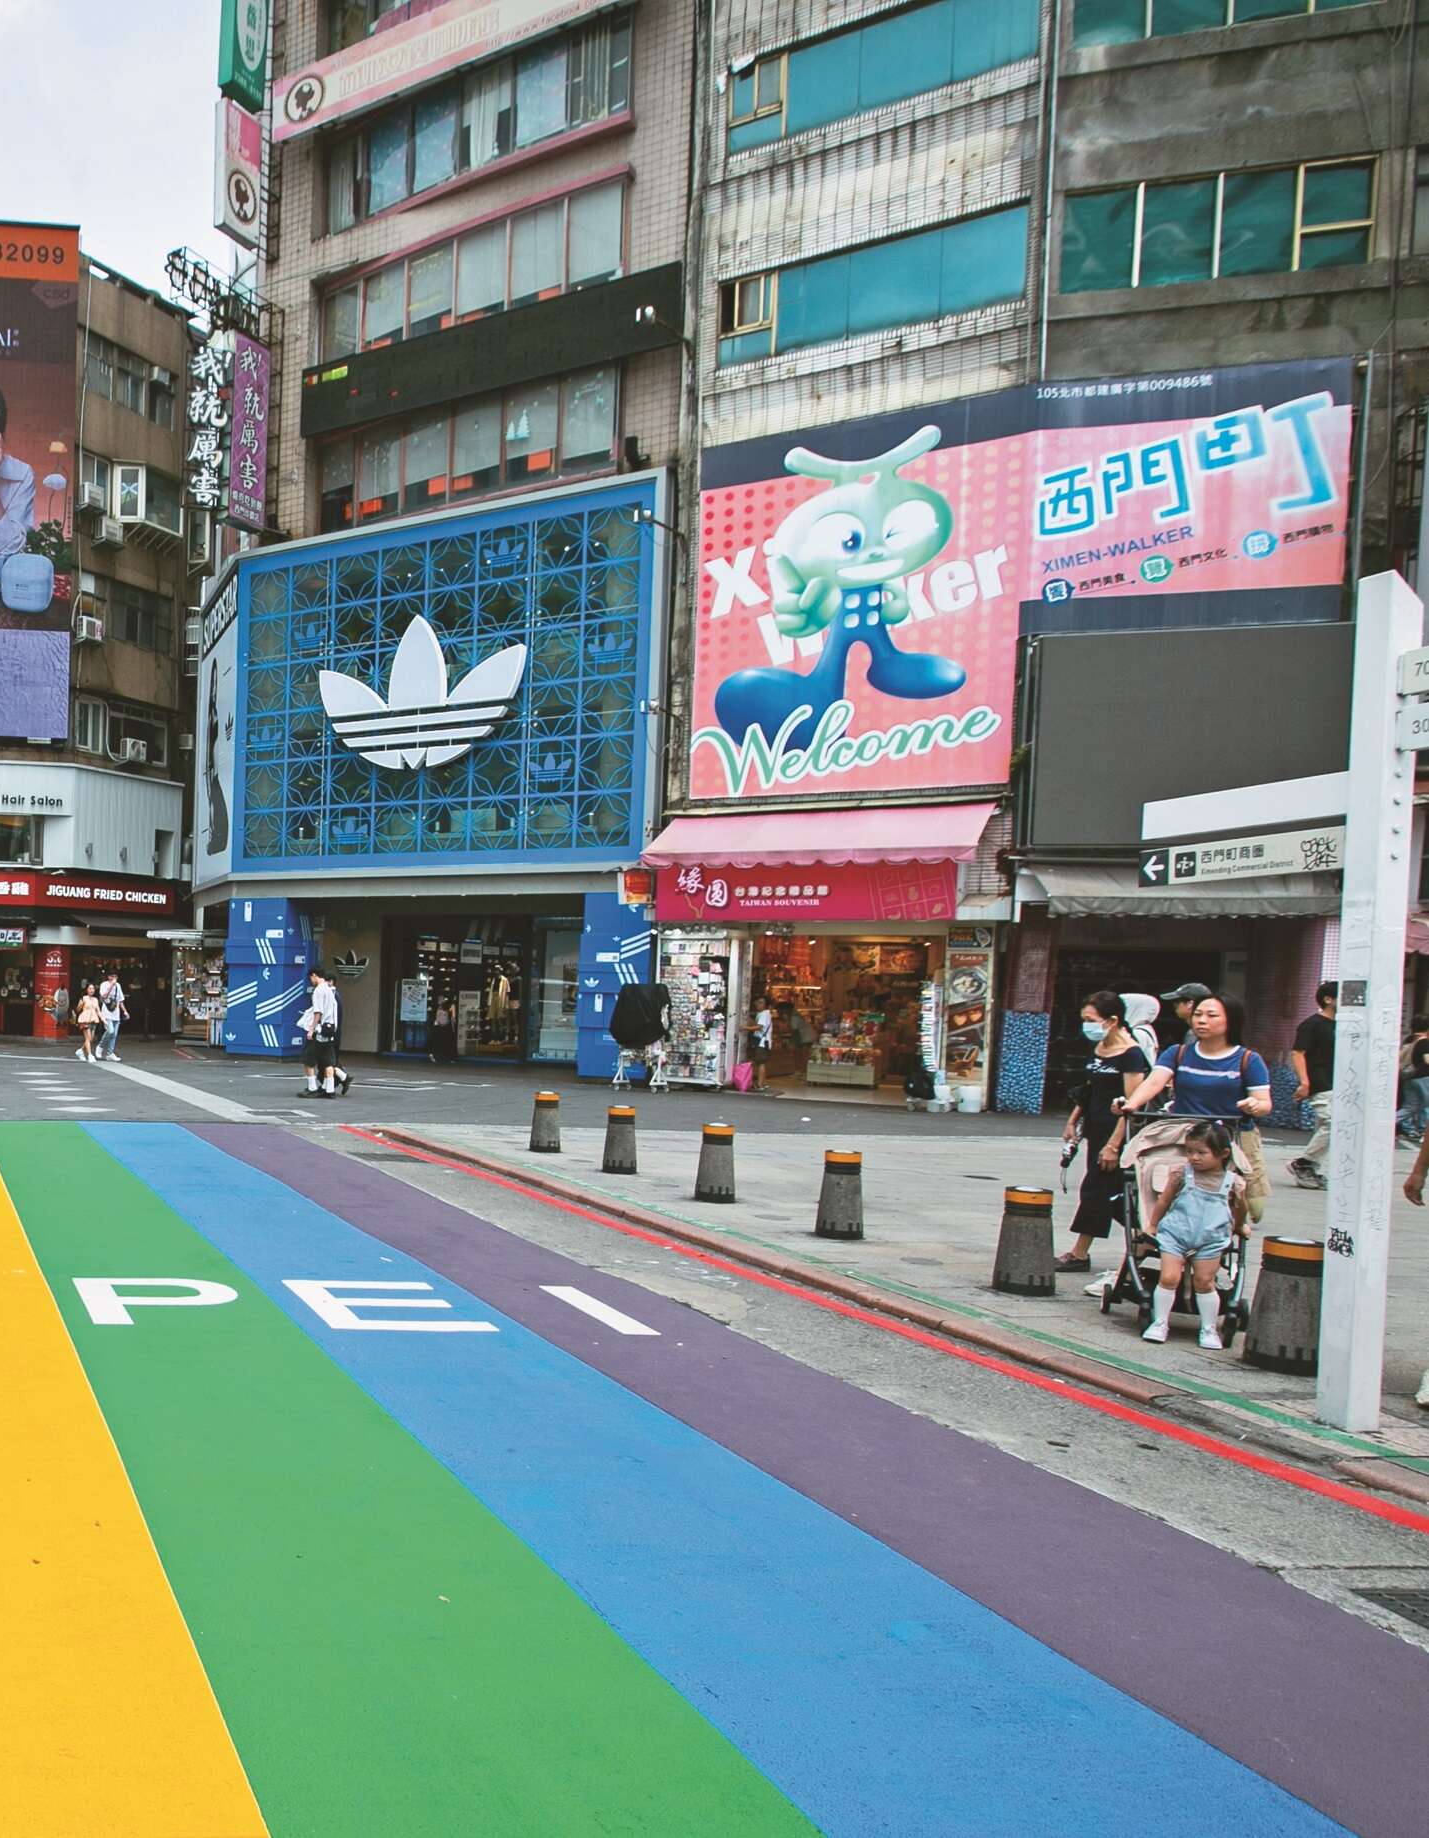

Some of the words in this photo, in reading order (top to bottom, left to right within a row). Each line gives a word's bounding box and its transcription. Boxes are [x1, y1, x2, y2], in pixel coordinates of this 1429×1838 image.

[1035, 391, 1339, 537] 西門町
[1042, 526, 1194, 575] XIMEN-WALKER
[1178, 547, 1227, 568] 西門文化
[1079, 572, 1126, 592] 西門美食
[690, 699, 1002, 797] Welcome
[1, 794, 25, 805] Hair
[30, 795, 63, 807] Salon
[1200, 843, 1264, 864] 西門町商圈
[1201, 866, 1231, 875] Ximending
[1232, 862, 1268, 873] Commercial
[1270, 859, 1294, 869] District
[46, 884, 91, 898] JIGUANG
[93, 888, 123, 901] FRIED
[125, 891, 167, 905] CHICKEN
[739, 899, 771, 907] TAIWAN
[774, 898, 820, 907] SOUVENIR
